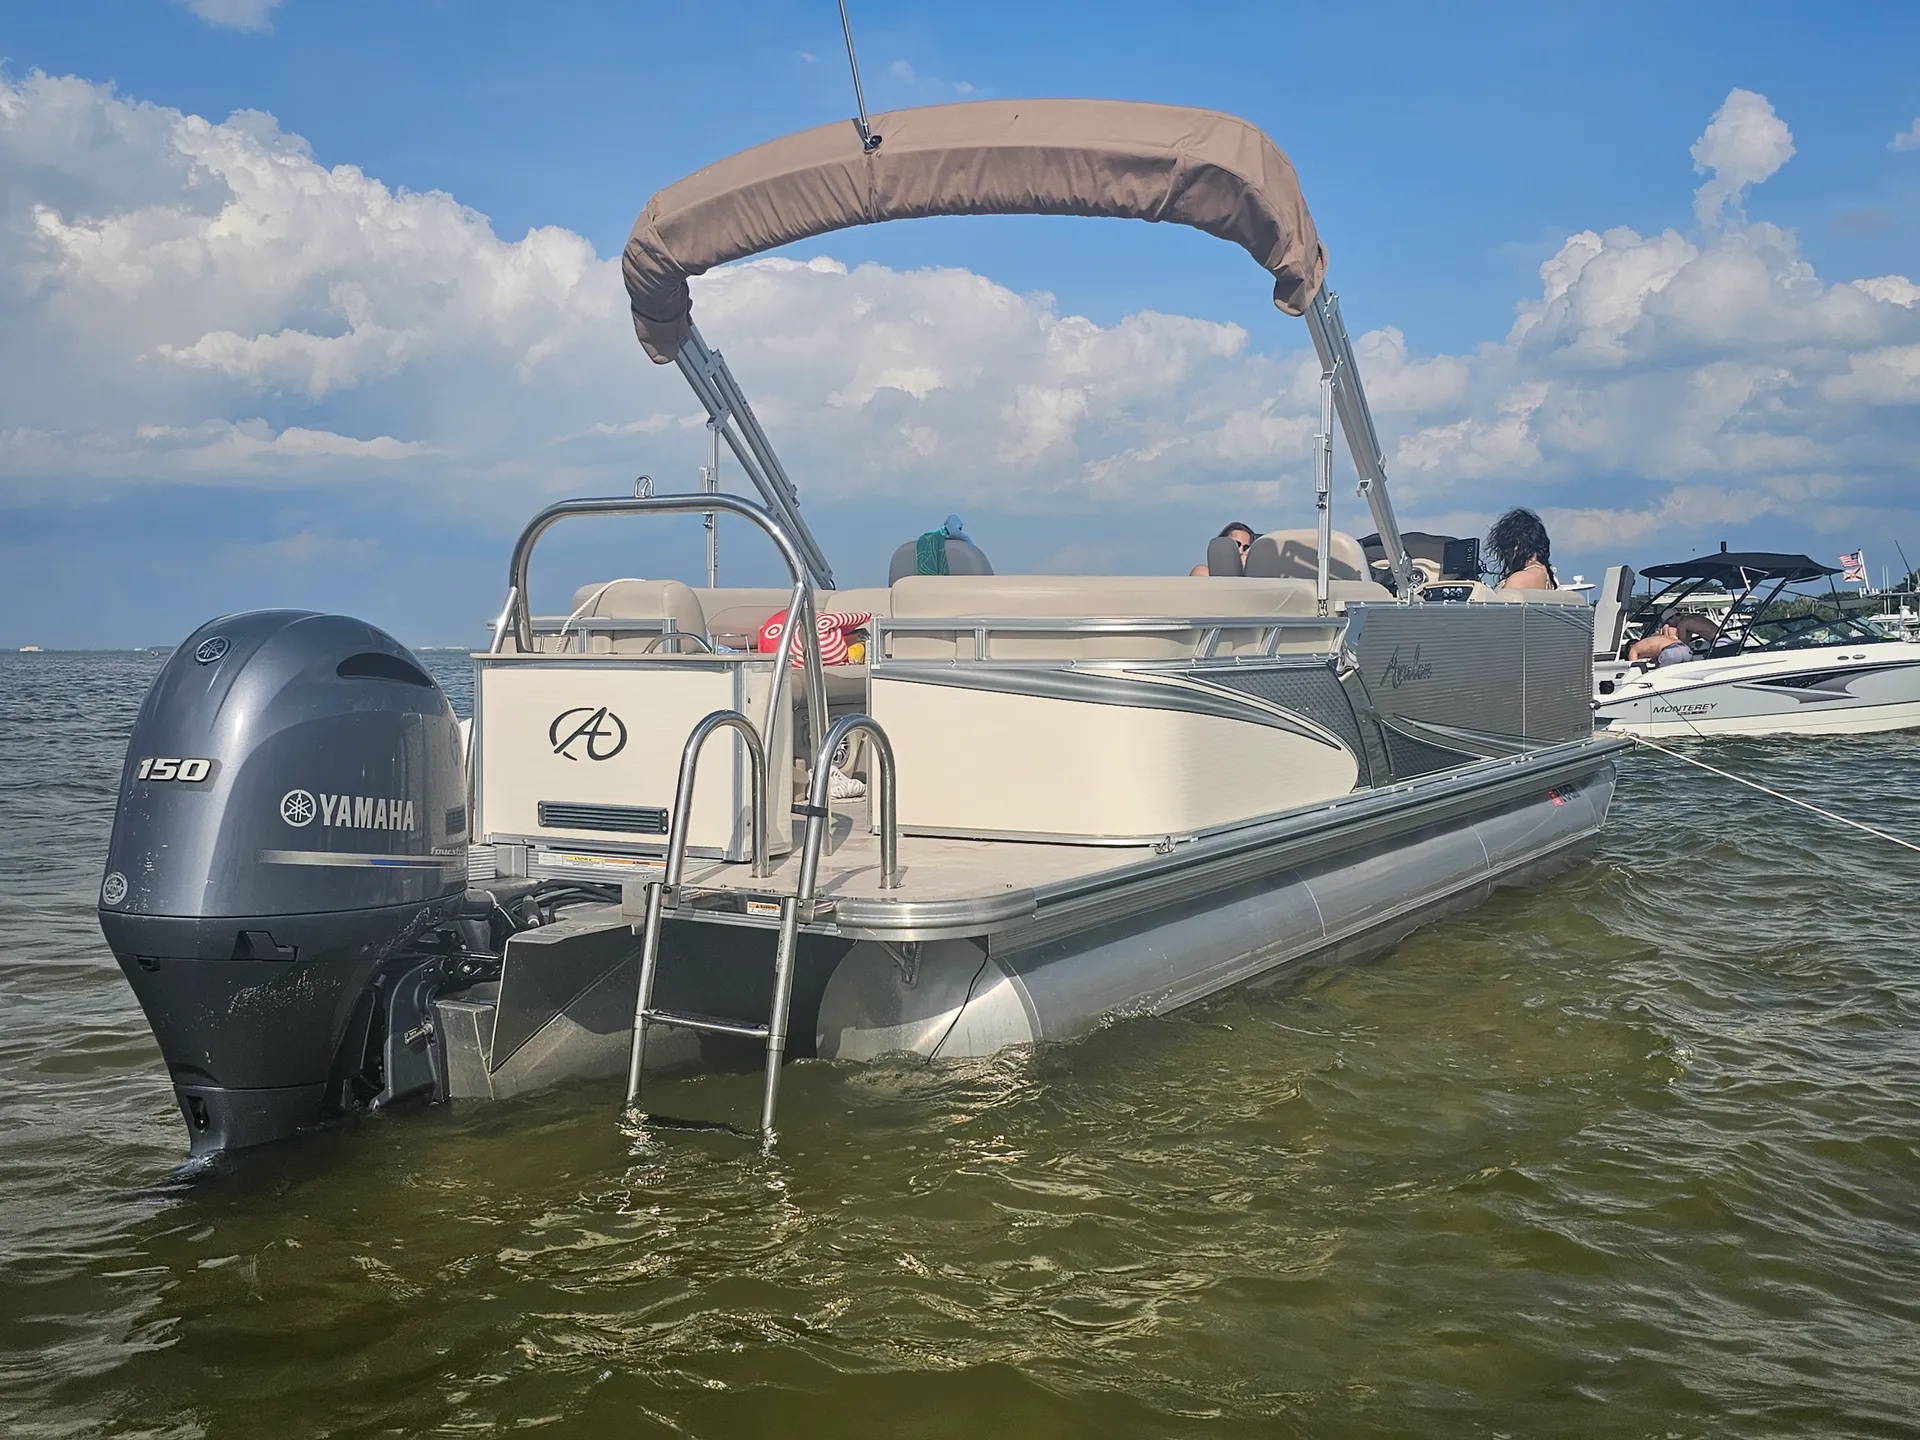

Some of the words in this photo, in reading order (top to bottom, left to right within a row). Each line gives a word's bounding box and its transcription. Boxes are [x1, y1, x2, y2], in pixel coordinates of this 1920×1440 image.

[1652, 702, 1718, 713] MONTEREY
[138, 758, 212, 782] 150
[319, 793, 415, 832] YAMAHA
